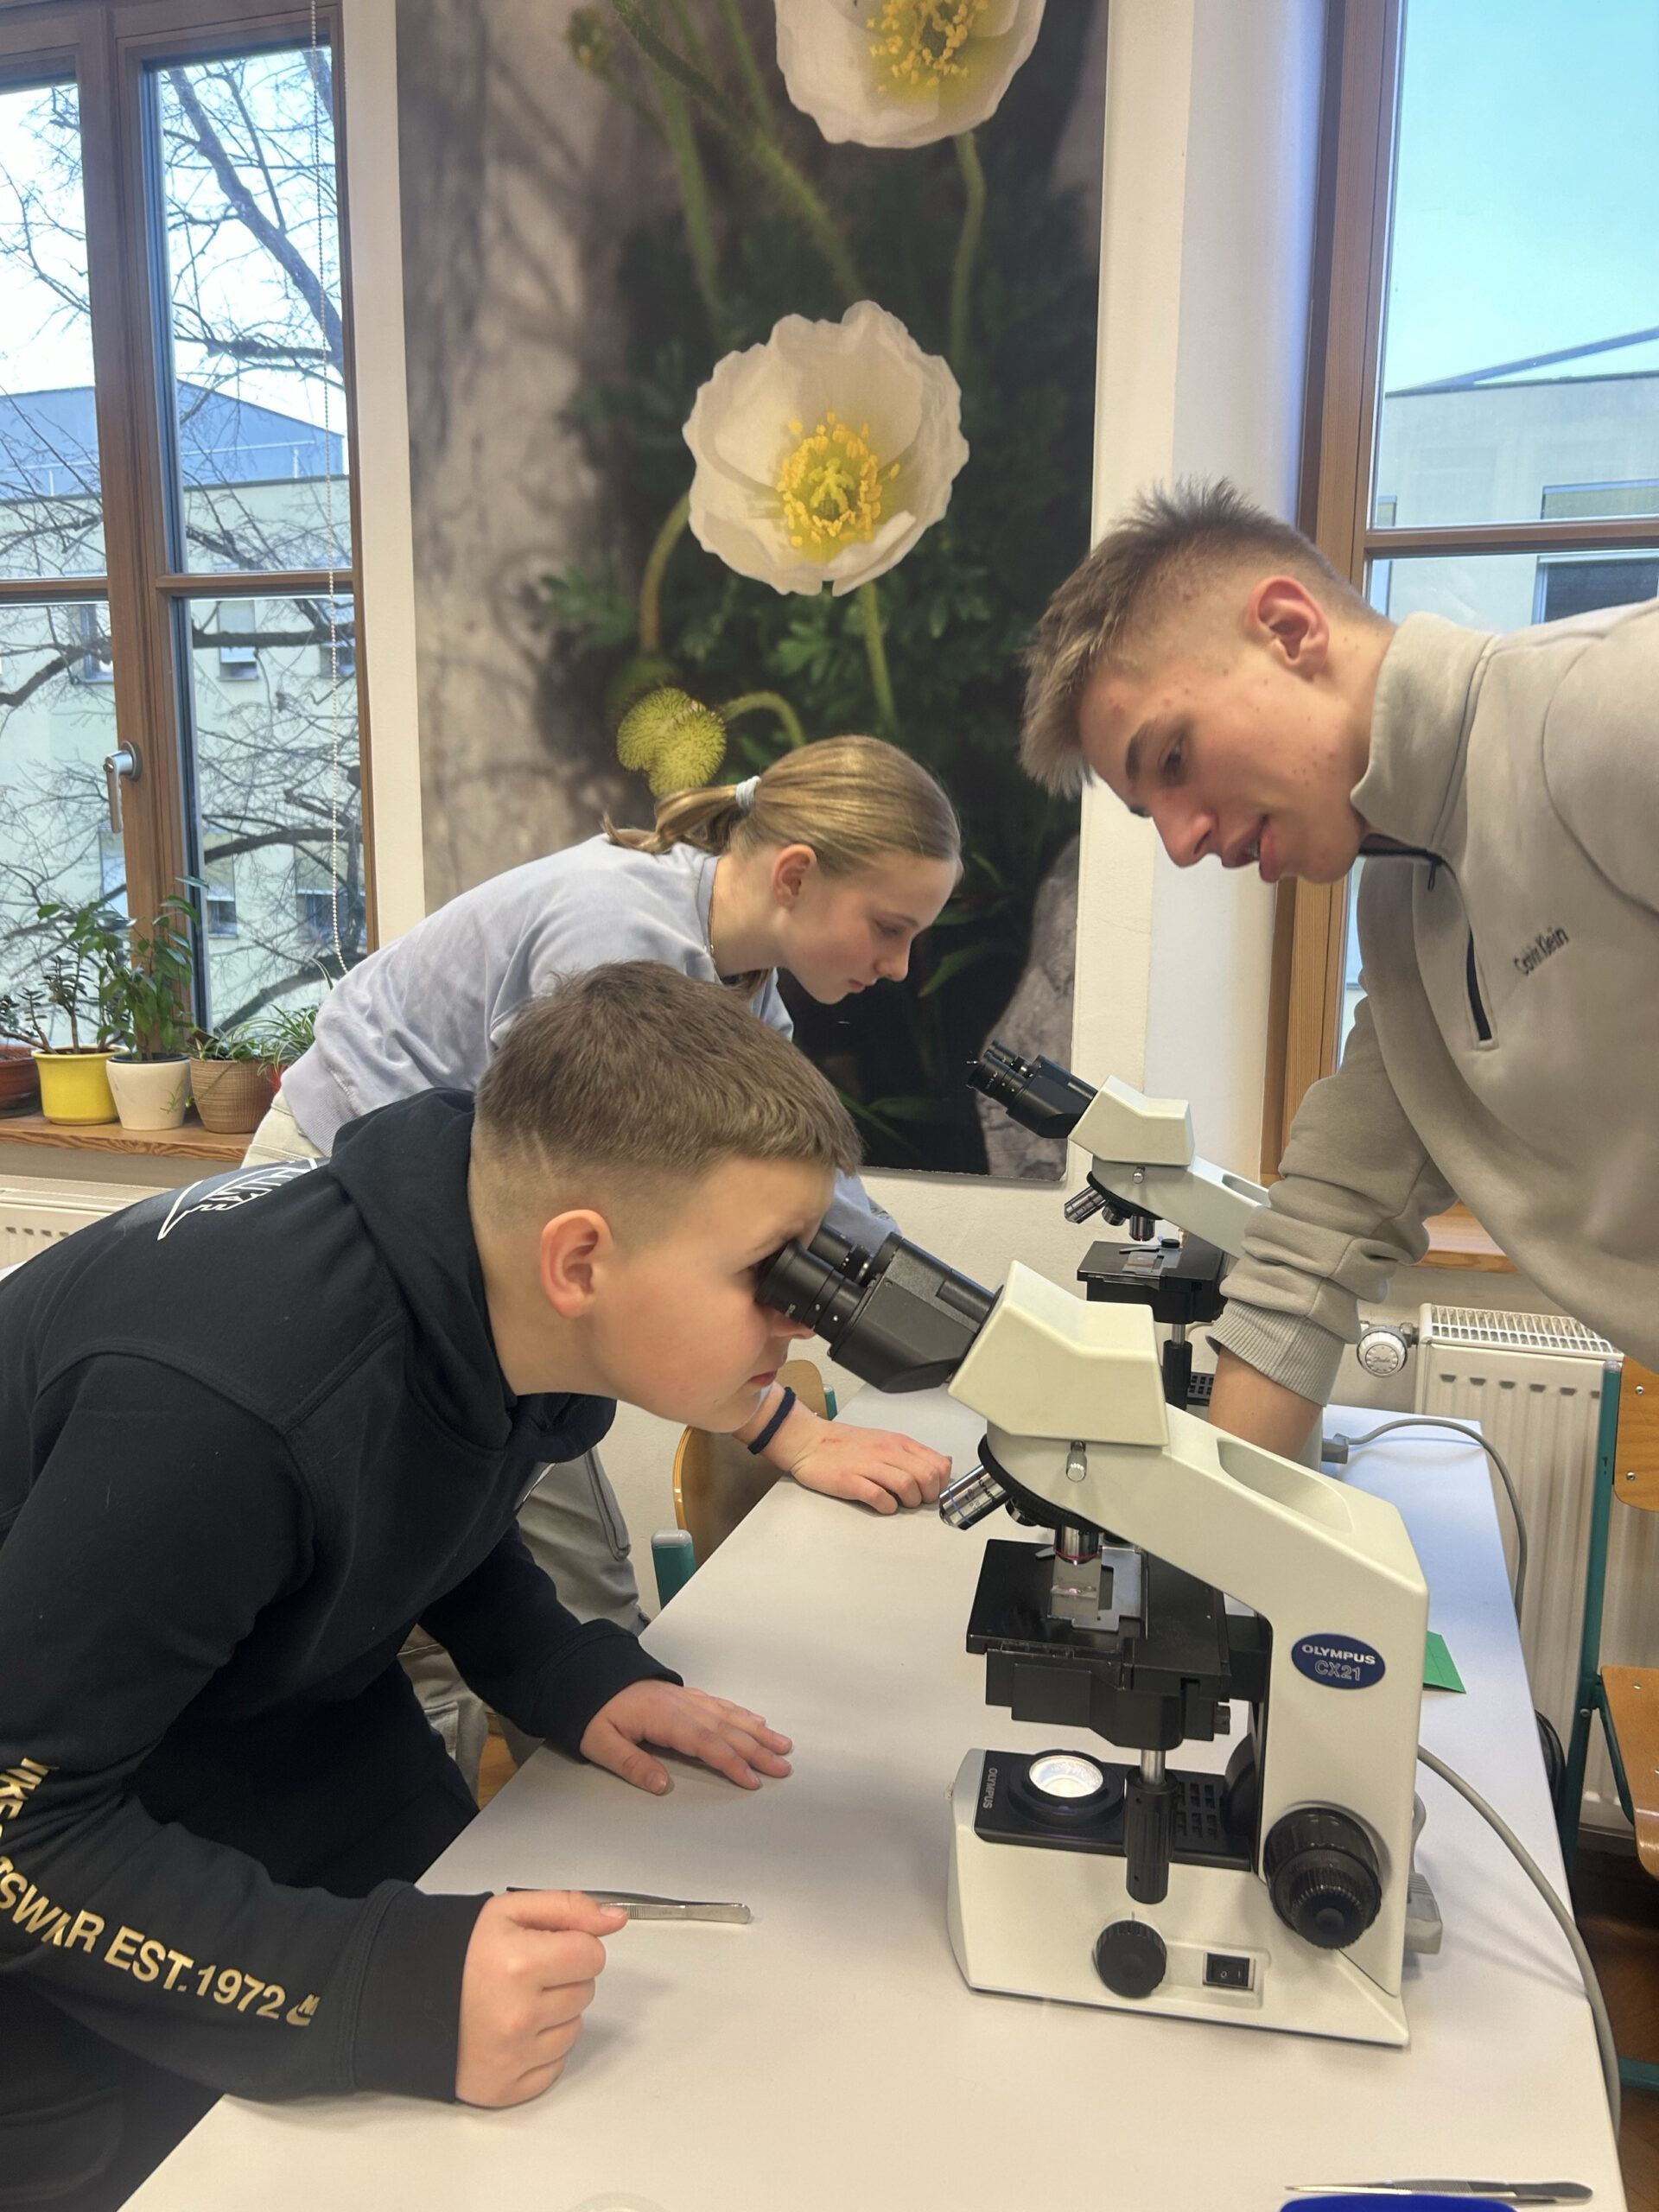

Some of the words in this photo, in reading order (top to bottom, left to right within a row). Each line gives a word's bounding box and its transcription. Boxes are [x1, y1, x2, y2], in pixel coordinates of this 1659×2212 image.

[1300, 1643, 1376, 1666] OLYMPUS
[1314, 1659, 1361, 1681] CX21
[982, 1767, 998, 1809] OLYMPUS
